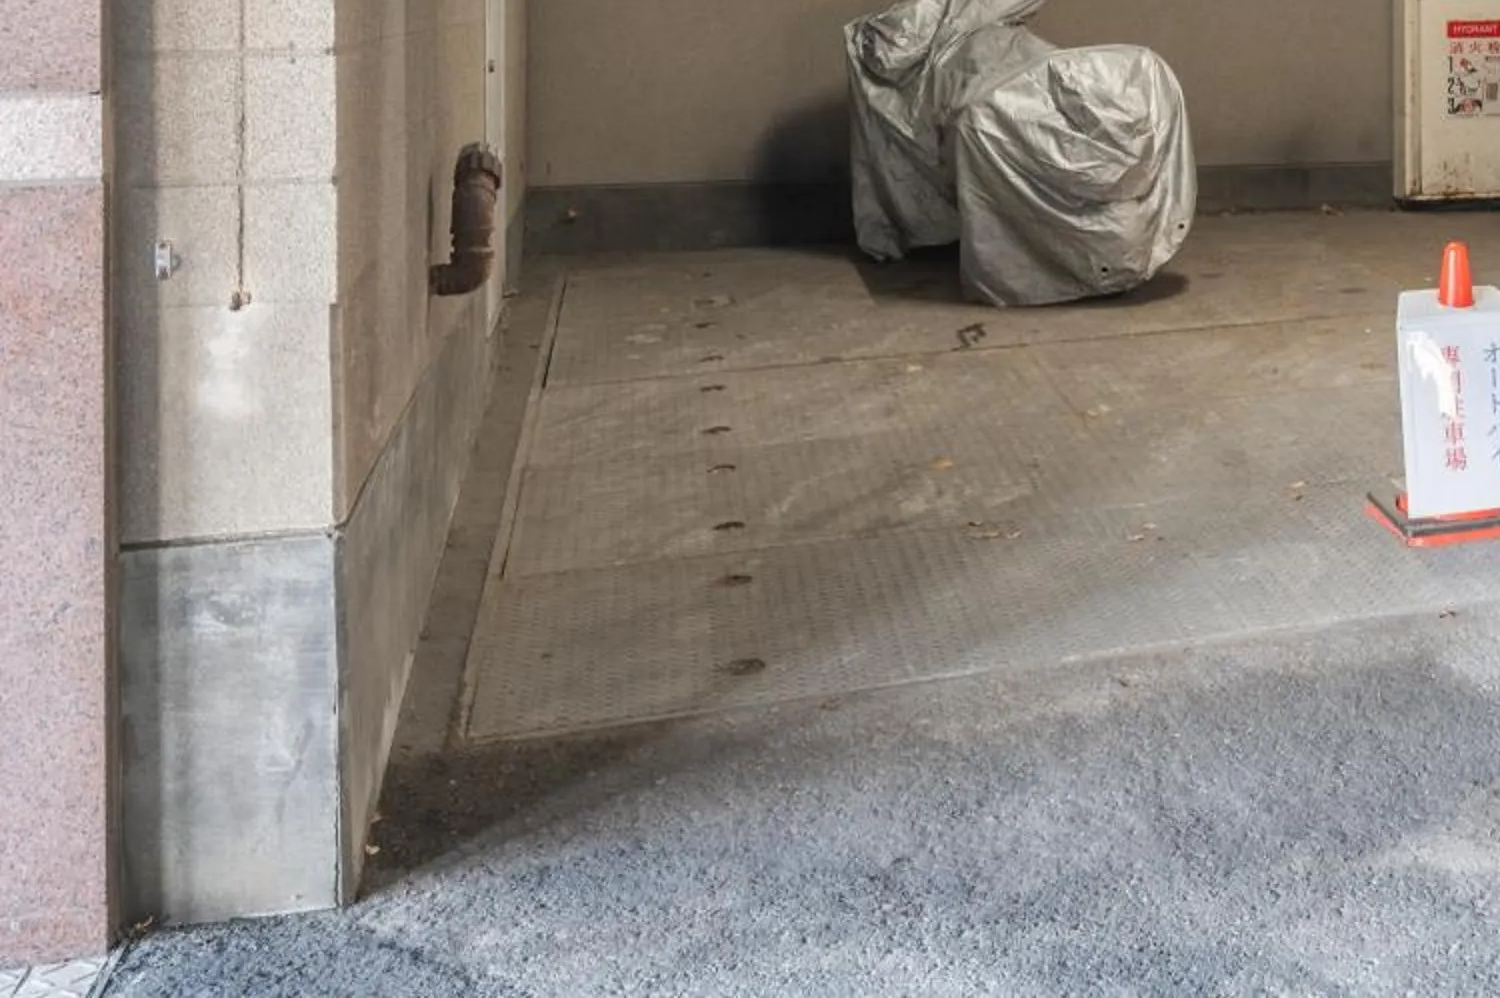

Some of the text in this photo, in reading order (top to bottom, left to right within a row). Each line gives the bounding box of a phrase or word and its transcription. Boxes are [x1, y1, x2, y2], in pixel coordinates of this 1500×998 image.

[1453, 25, 1497, 35] HYDRANT
[1447, 77, 1454, 94] 2
[1447, 97, 1455, 115] 3
